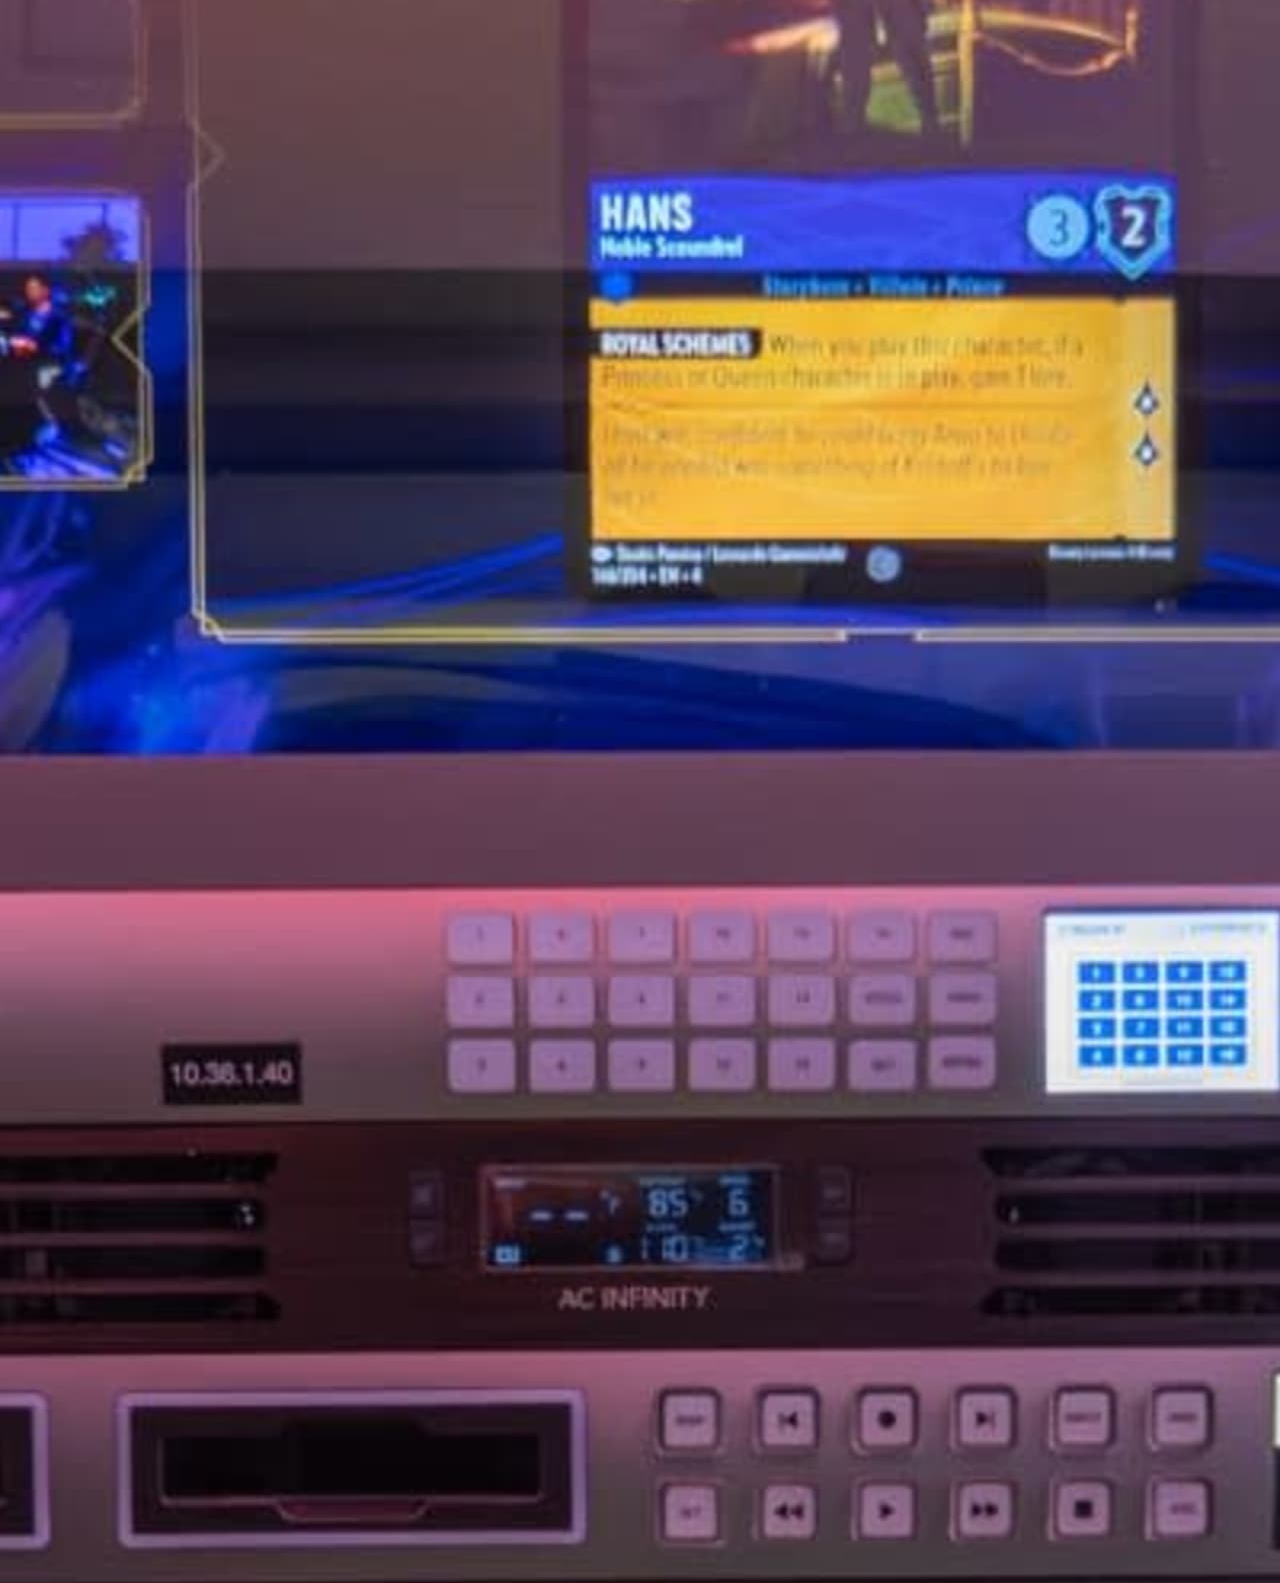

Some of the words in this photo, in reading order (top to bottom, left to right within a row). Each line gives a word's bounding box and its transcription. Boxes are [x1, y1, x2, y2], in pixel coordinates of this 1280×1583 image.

[600, 193, 694, 233] HANS
[1049, 208, 1069, 246] 3
[1121, 206, 1146, 247] 2
[600, 330, 658, 357] ROYAL
[168, 1059, 293, 1089] 10.36.1.40
[647, 1189, 688, 1217] 85
[727, 1189, 749, 1217] 6
[558, 1287, 595, 1310] AC
[601, 1286, 713, 1309] INFINITY
